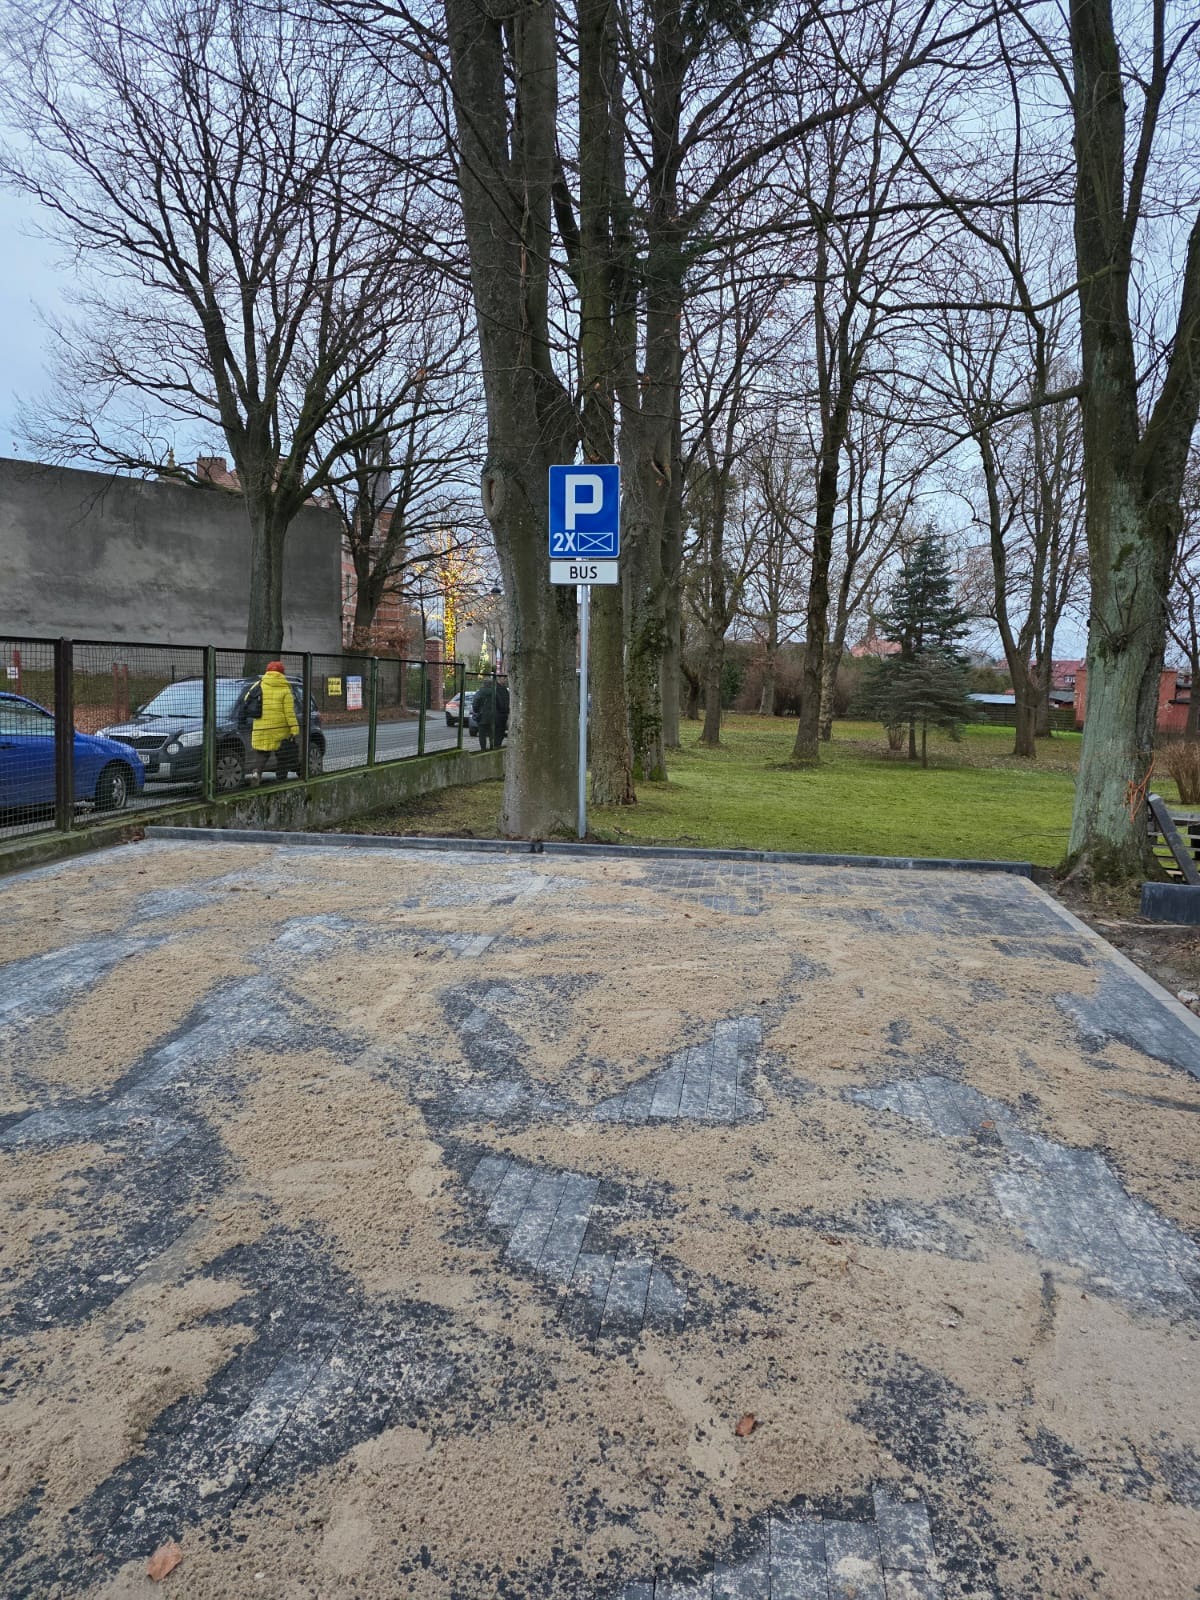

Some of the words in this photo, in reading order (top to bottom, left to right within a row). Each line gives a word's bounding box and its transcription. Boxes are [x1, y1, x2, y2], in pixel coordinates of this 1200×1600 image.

[565, 474, 603, 530] P
[553, 532, 576, 551] 2X
[570, 566, 597, 579] BUS
